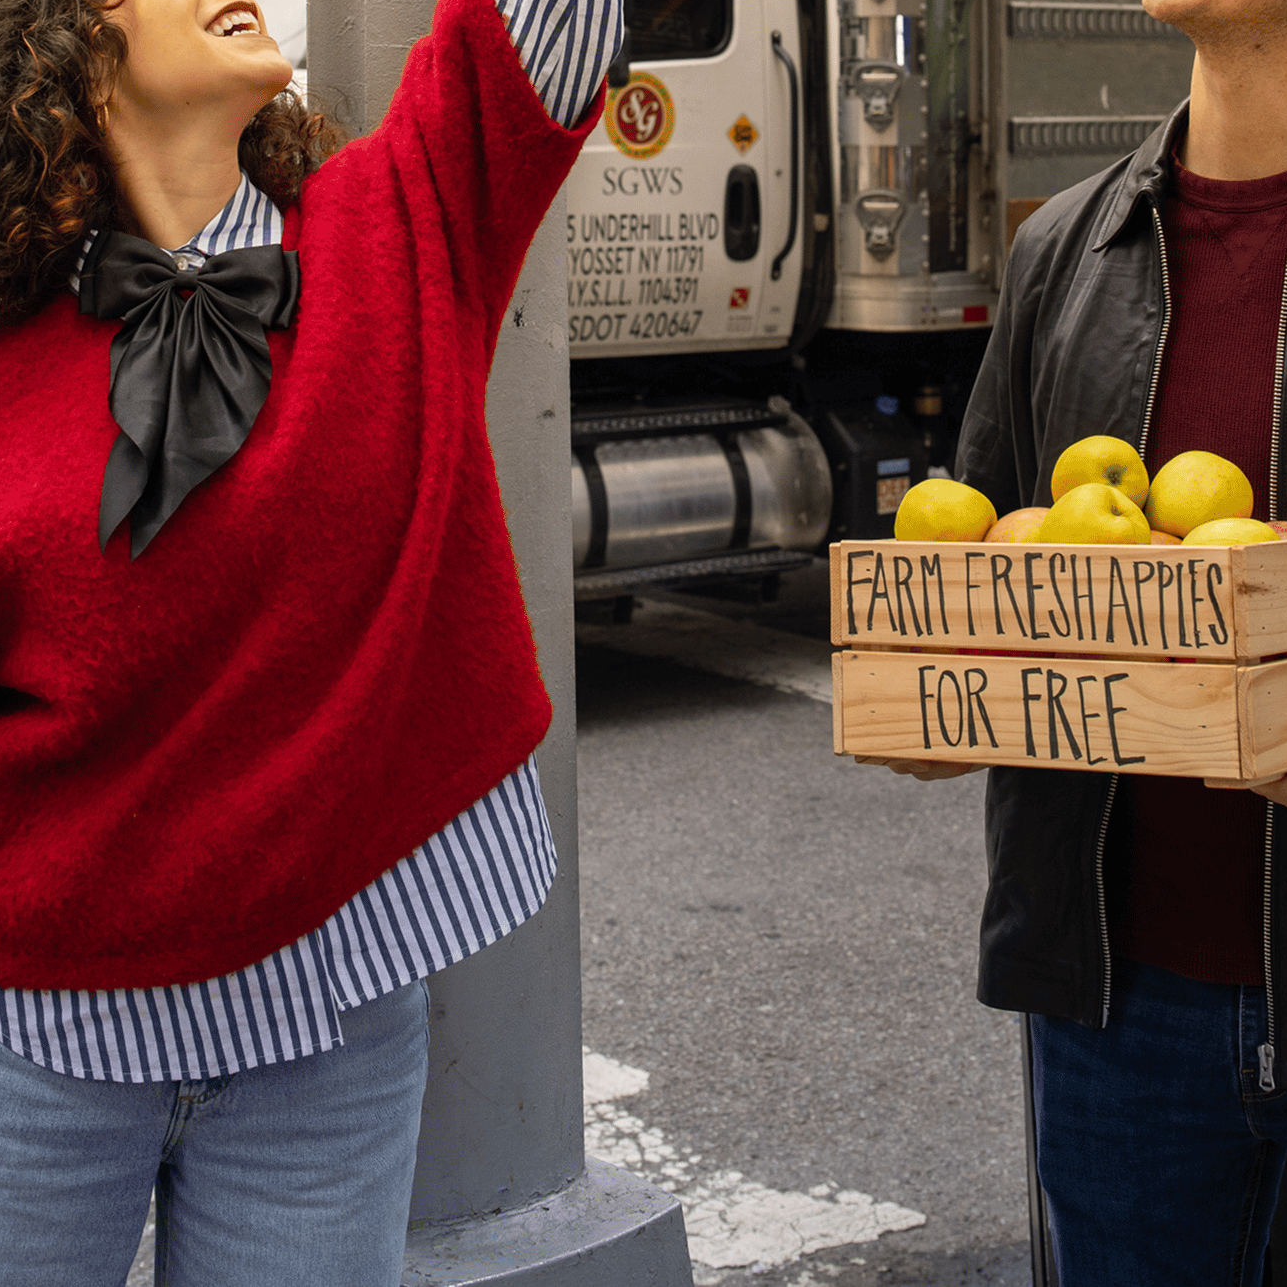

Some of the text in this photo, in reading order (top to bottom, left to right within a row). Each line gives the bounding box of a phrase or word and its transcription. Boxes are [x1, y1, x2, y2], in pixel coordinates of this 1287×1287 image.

[602, 167, 683, 196] SGWS
[582, 213, 674, 243] UNDERHILL
[679, 213, 720, 241] BLVD
[568, 245, 705, 275] YOSSET NY 11791
[639, 277, 699, 305] 1104391
[569, 314, 628, 342] SDOT
[629, 310, 704, 339] 420647
[847, 550, 1229, 650] FARM FRESH APPLES
[919, 665, 1146, 767] FOR FREE
